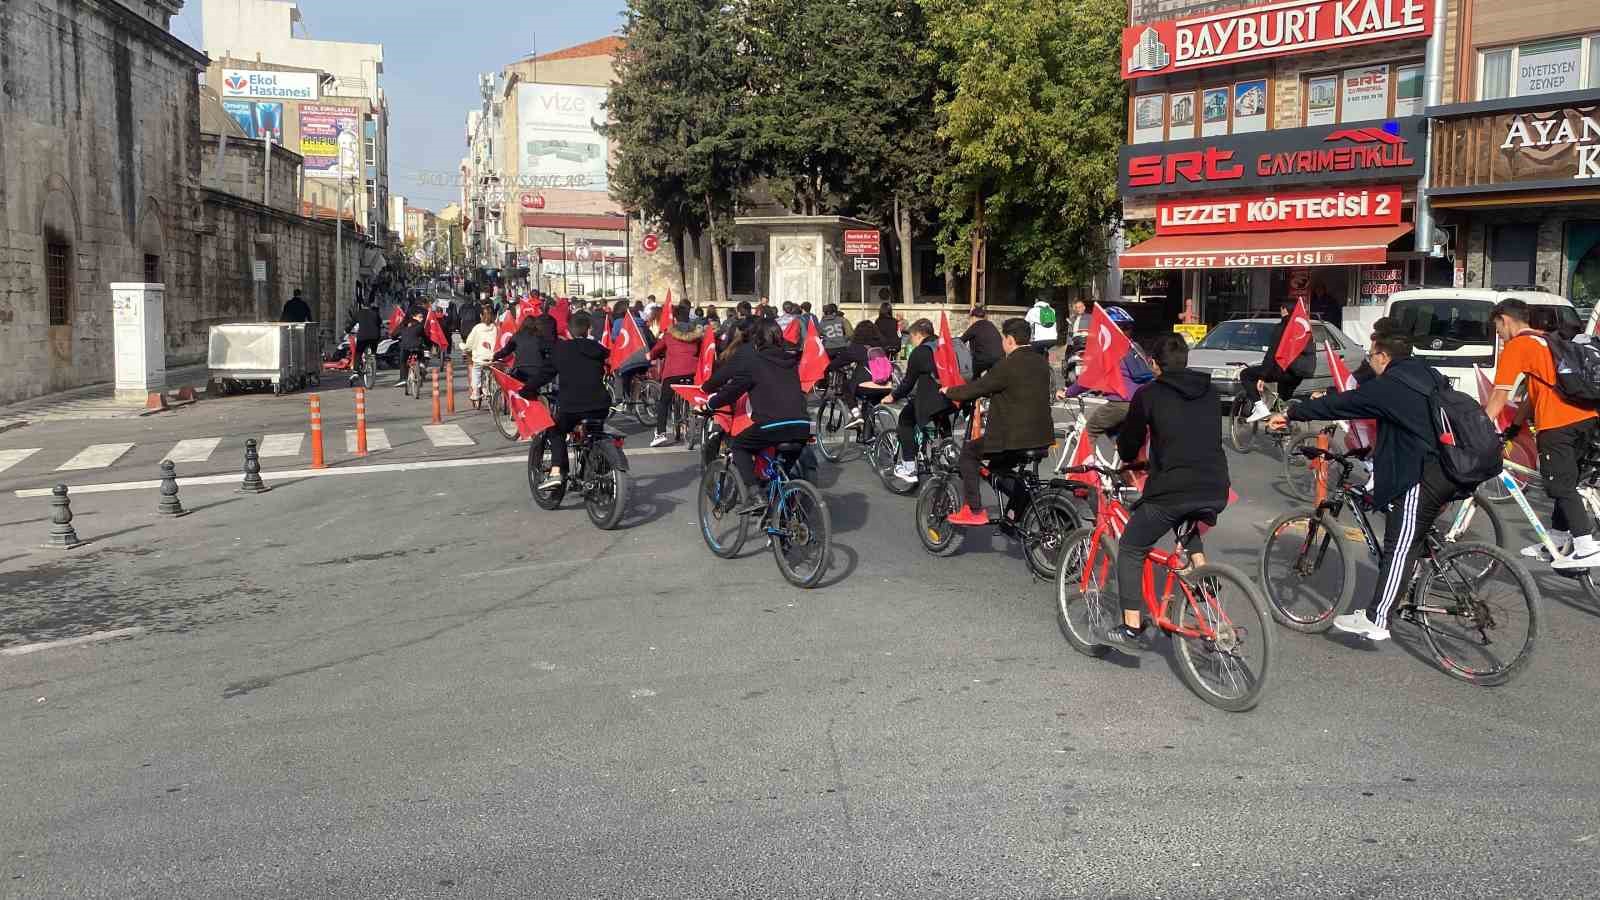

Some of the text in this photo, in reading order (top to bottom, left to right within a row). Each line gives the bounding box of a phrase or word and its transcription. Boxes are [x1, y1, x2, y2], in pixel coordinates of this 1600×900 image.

[1175, 0, 1424, 61] BAYBURT KALE
[249, 74, 277, 86] Ekol
[1529, 76, 1565, 91] ZEYNEP
[249, 86, 311, 97] Hastanesi
[1160, 190, 1392, 227] LEZZET KÖFTECİSİ 2
[1154, 255, 1217, 269] LEZZET
[1223, 251, 1321, 267] KÖFTECİSİ
[824, 323, 844, 338] 25
